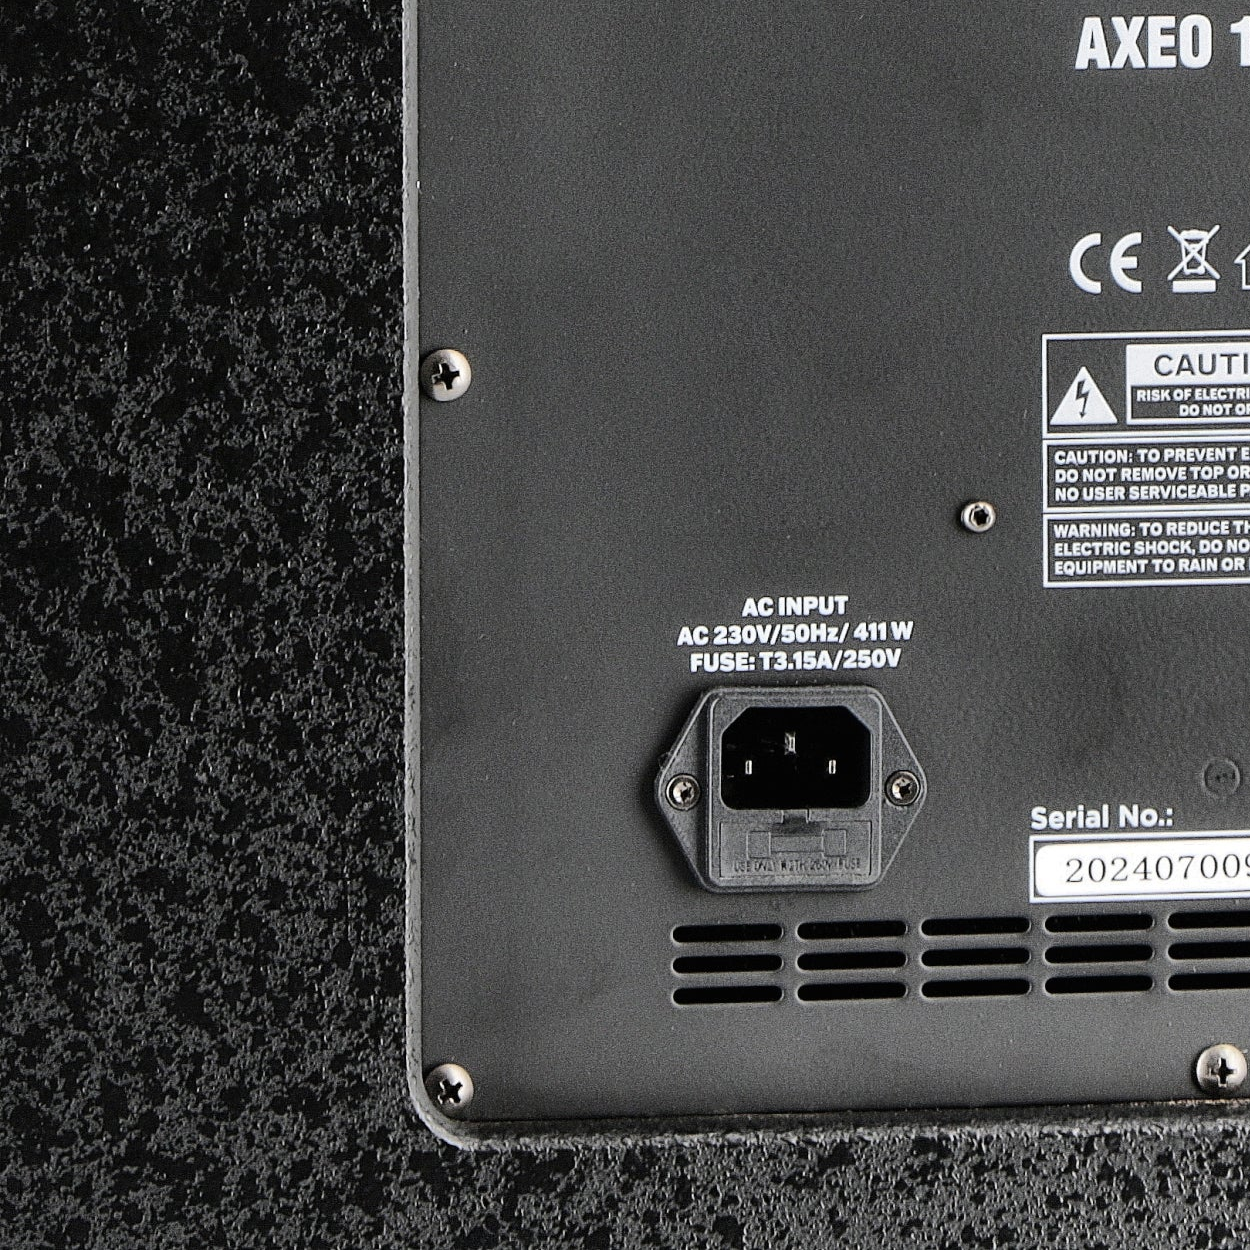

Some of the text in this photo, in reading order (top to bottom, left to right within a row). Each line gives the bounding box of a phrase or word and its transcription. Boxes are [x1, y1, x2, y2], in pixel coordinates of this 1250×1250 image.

[1075, 15, 1212, 69] AXEO
[1137, 389, 1170, 401] RISK
[1173, 388, 1191, 401] OF
[1179, 404, 1199, 416] DO
[1203, 404, 1232, 415] NOT
[1055, 450, 1132, 465] CAUTION:
[1137, 449, 1160, 462] TO
[1164, 447, 1237, 462] PREVENT
[1055, 469, 1078, 483] DO
[1083, 468, 1117, 482] NOT
[1121, 467, 1187, 481] REMOVE
[1190, 466, 1224, 480] TOP
[1227, 465, 1250, 479] OR
[1055, 487, 1079, 501] NO
[1083, 486, 1125, 501] USER
[1129, 484, 1236, 500] SERVICEABLE
[1054, 523, 1135, 538] WARNING:
[1139, 522, 1162, 536] TO
[1166, 521, 1229, 536] REDUCE
[1055, 541, 1130, 556] ELECTRIC
[1134, 540, 1195, 555] SHOCK,
[1199, 539, 1223, 553] DO
[1055, 560, 1148, 576] EQUIPMENT
[1152, 559, 1175, 573] TO
[1179, 558, 1217, 572] RAIN
[1221, 557, 1245, 571] OR
[742, 595, 848, 616] AC INPUT
[677, 626, 708, 645] AC
[854, 622, 886, 641] 411
[691, 648, 901, 672] FUSE: T3.15A/250V
[1031, 804, 1172, 830] Serial No.:
